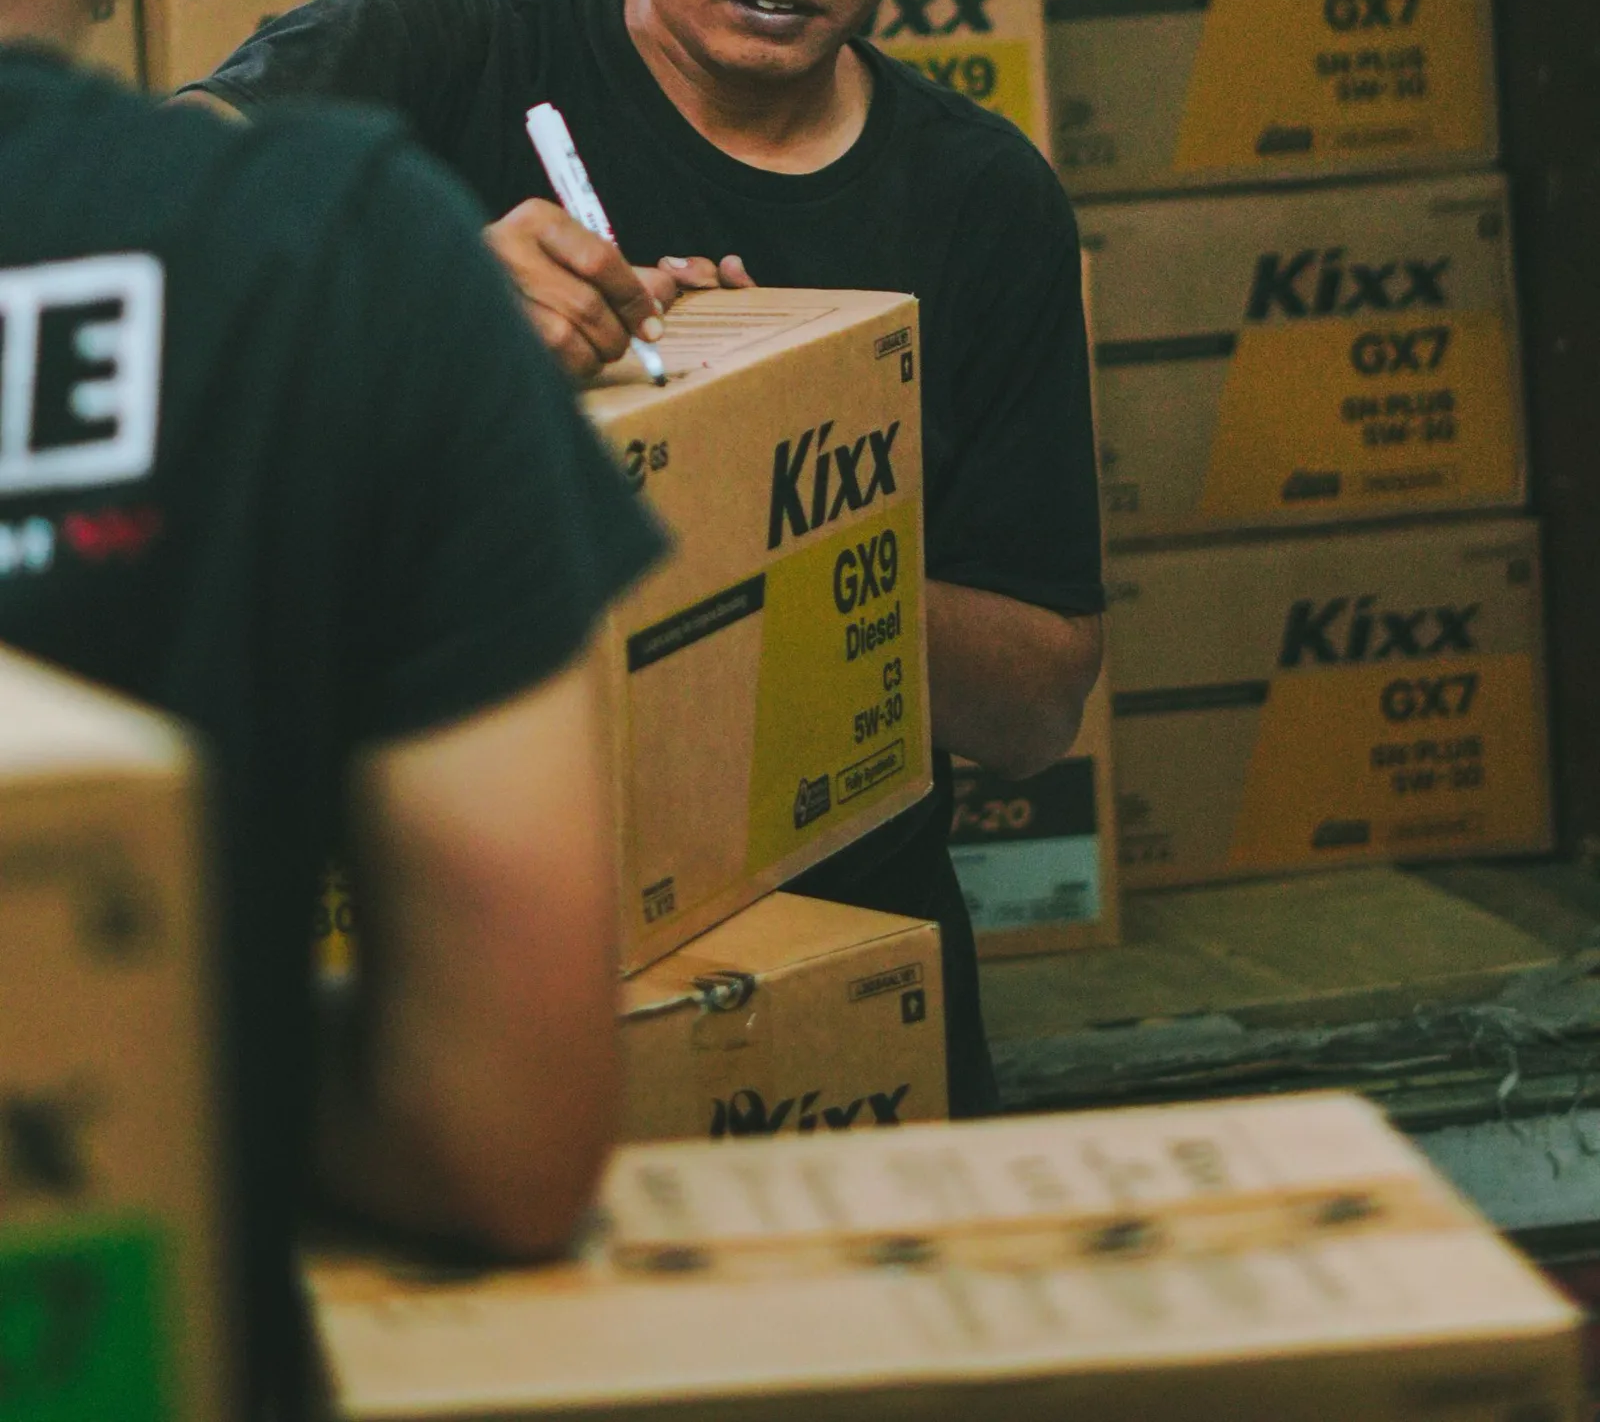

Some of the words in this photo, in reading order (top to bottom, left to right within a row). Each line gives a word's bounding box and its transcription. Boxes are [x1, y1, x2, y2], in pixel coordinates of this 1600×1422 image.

[1245, 246, 1448, 321] Kixx
[1351, 328, 1449, 377] GX7
[767, 420, 900, 551] Kixx
[833, 528, 898, 615] GX9
[846, 600, 901, 661] Diesel
[1277, 592, 1480, 668] Kixx
[882, 657, 902, 692] C3
[1380, 673, 1478, 722] GX7
[855, 693, 903, 744] 5W-30
